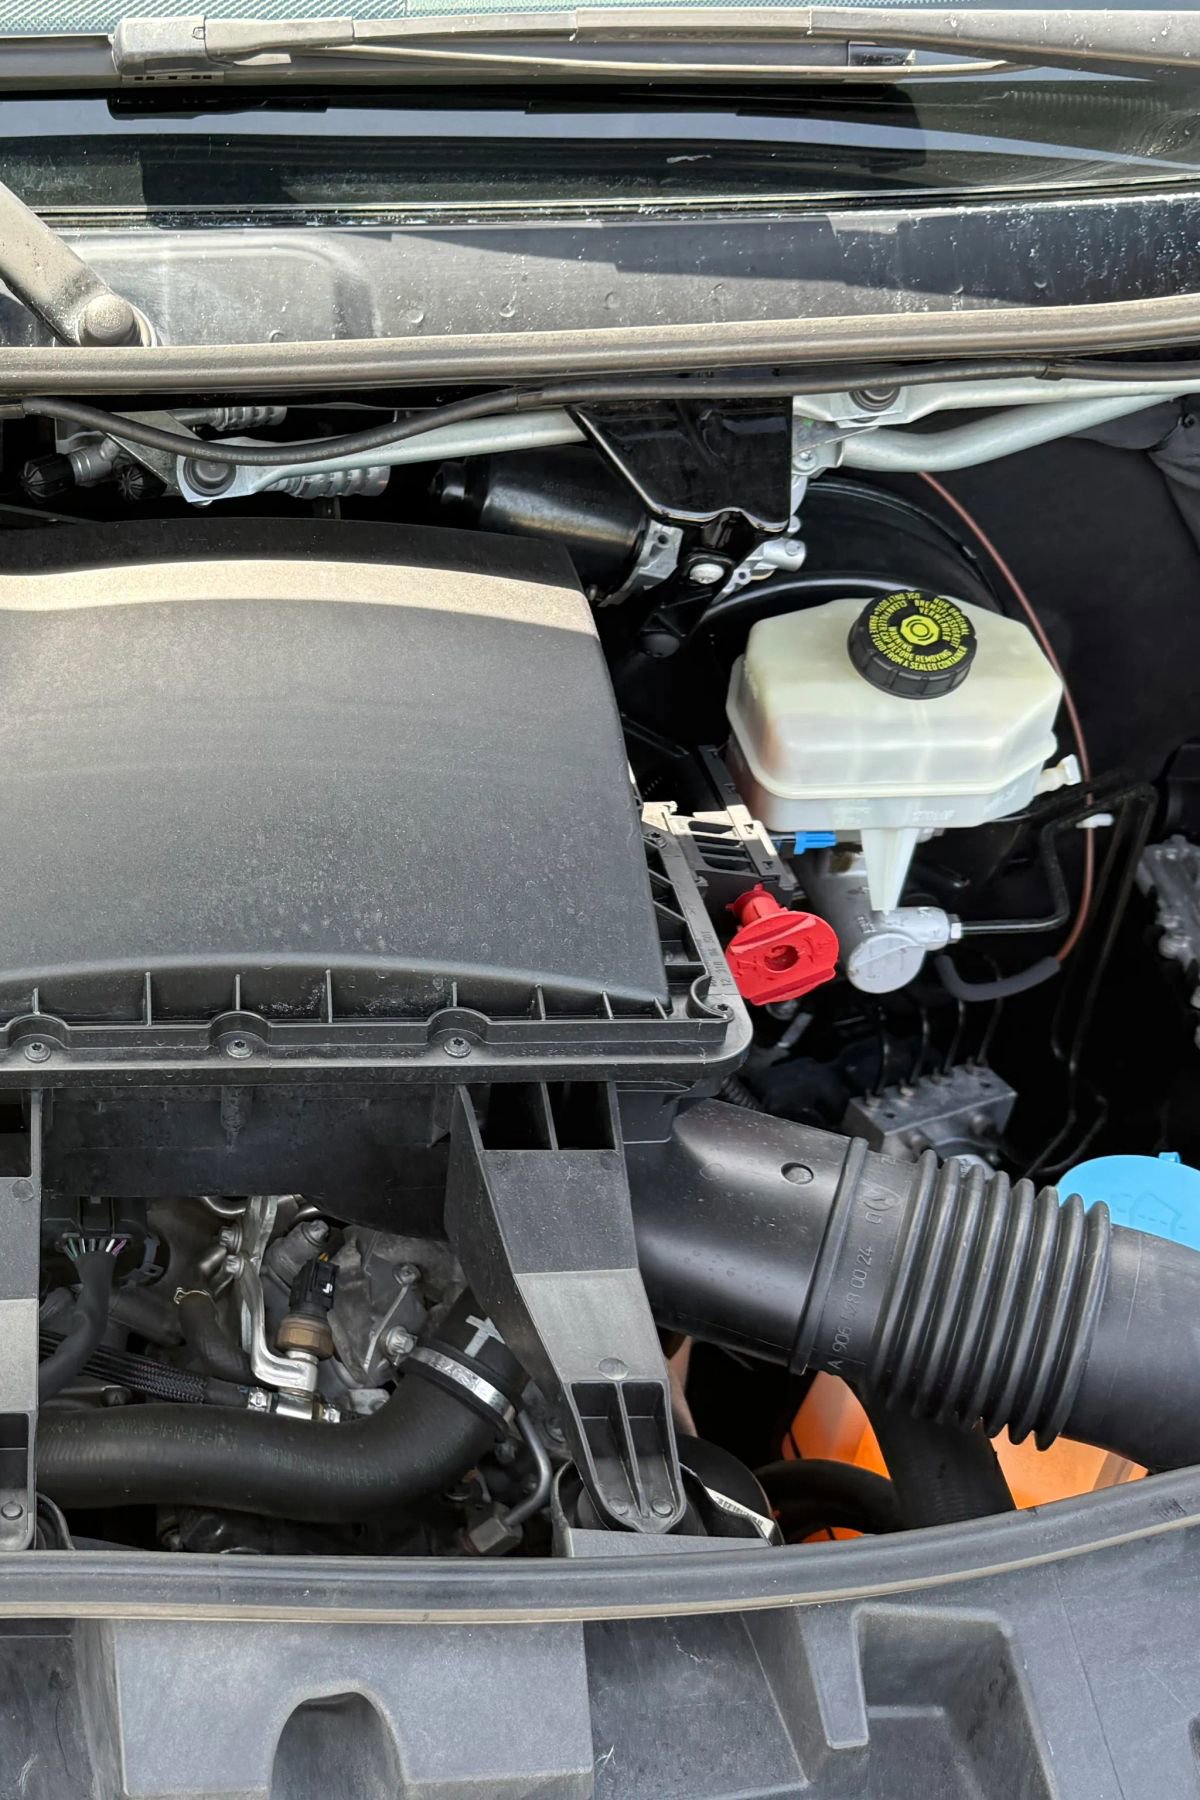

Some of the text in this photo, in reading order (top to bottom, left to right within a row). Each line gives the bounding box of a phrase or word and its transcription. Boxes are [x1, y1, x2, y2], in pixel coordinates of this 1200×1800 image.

[880, 632, 894, 643] CAP
[887, 642, 914, 661] BEFORE
[883, 650, 904, 665] FROM
[910, 662, 938, 671] SEALED
